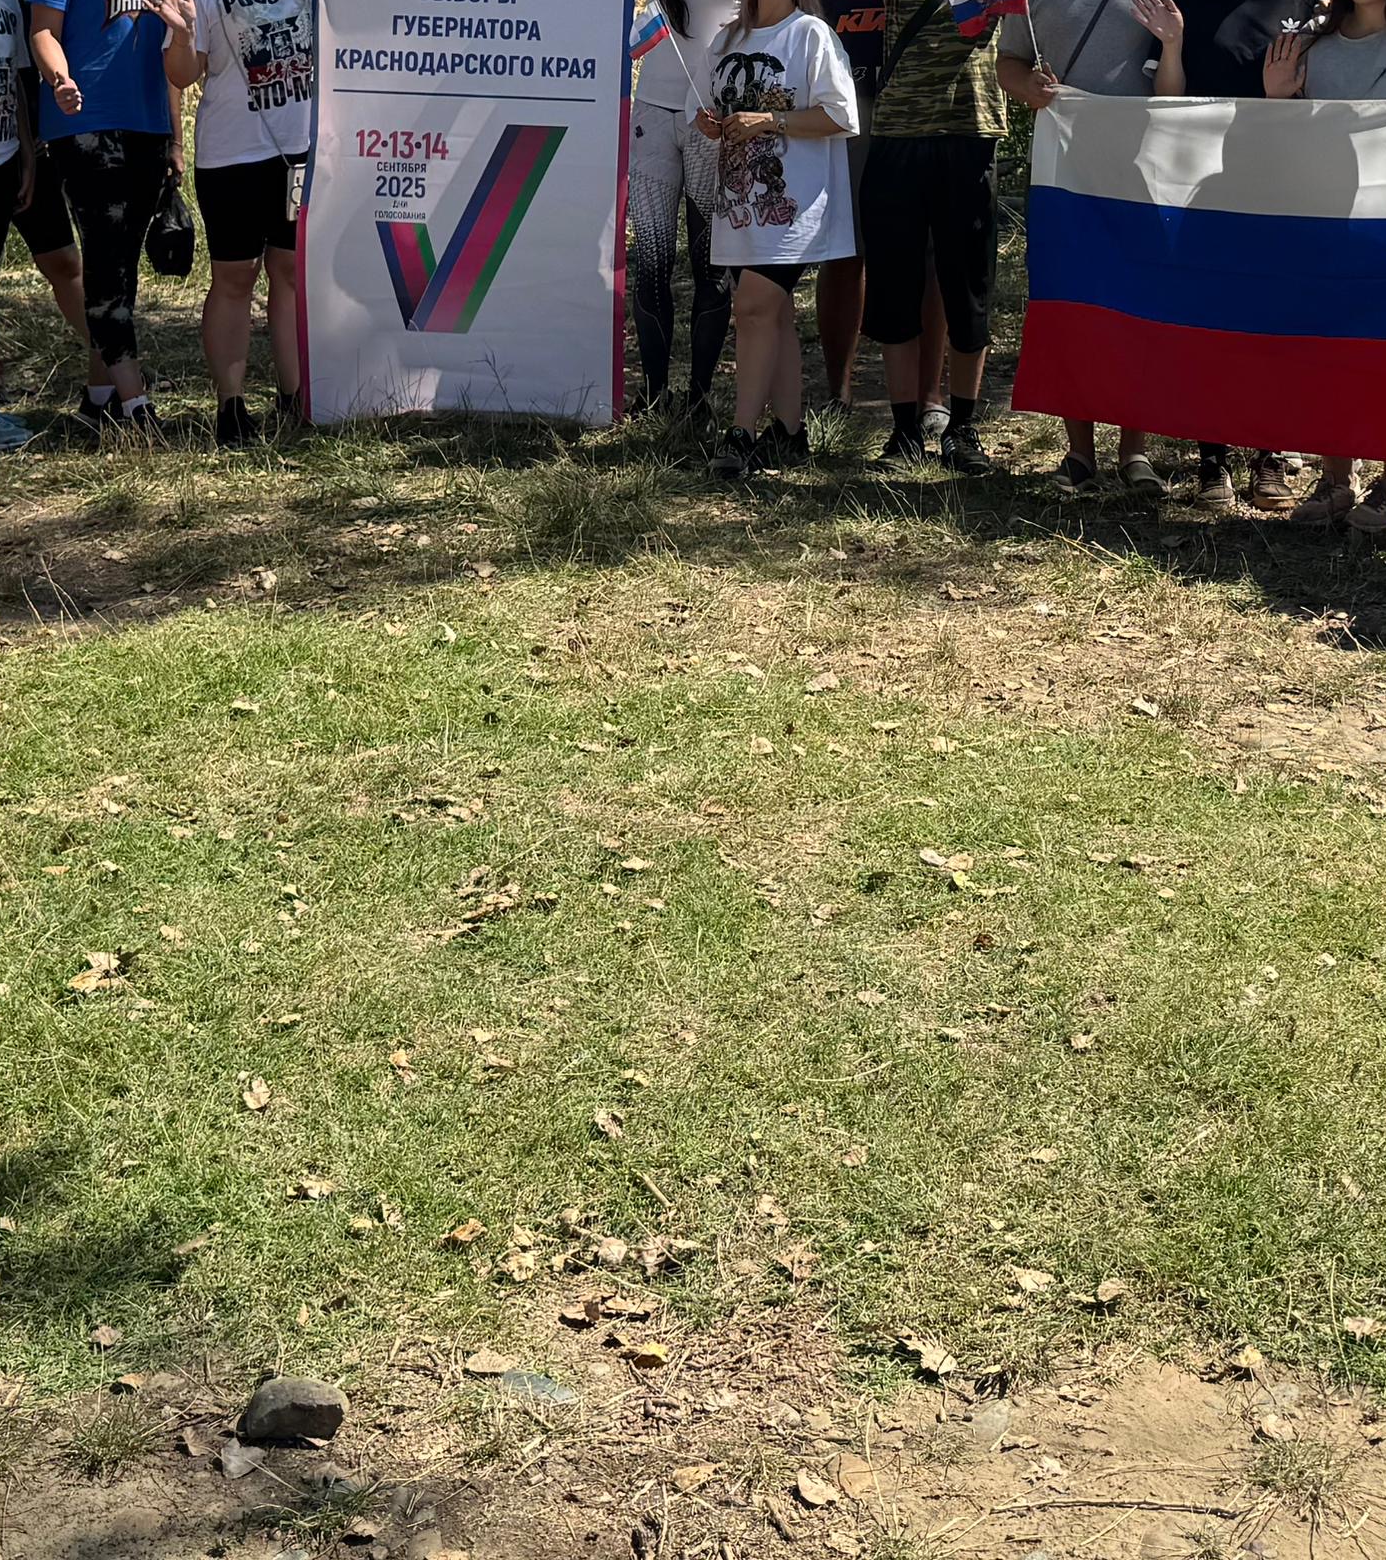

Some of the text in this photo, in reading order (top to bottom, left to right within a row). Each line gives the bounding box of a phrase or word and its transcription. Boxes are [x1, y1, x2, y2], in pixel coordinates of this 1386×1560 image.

[391, 14, 542, 41] ГУБЕРНАТОРА
[334, 48, 597, 80] КРАСНОДАРСКОГО КРАЯ
[376, 161, 427, 173] СЕНТЯБРЯ
[375, 175, 426, 199] 2025
[374, 209, 426, 220] ГОЛОСОВАНИЯ
